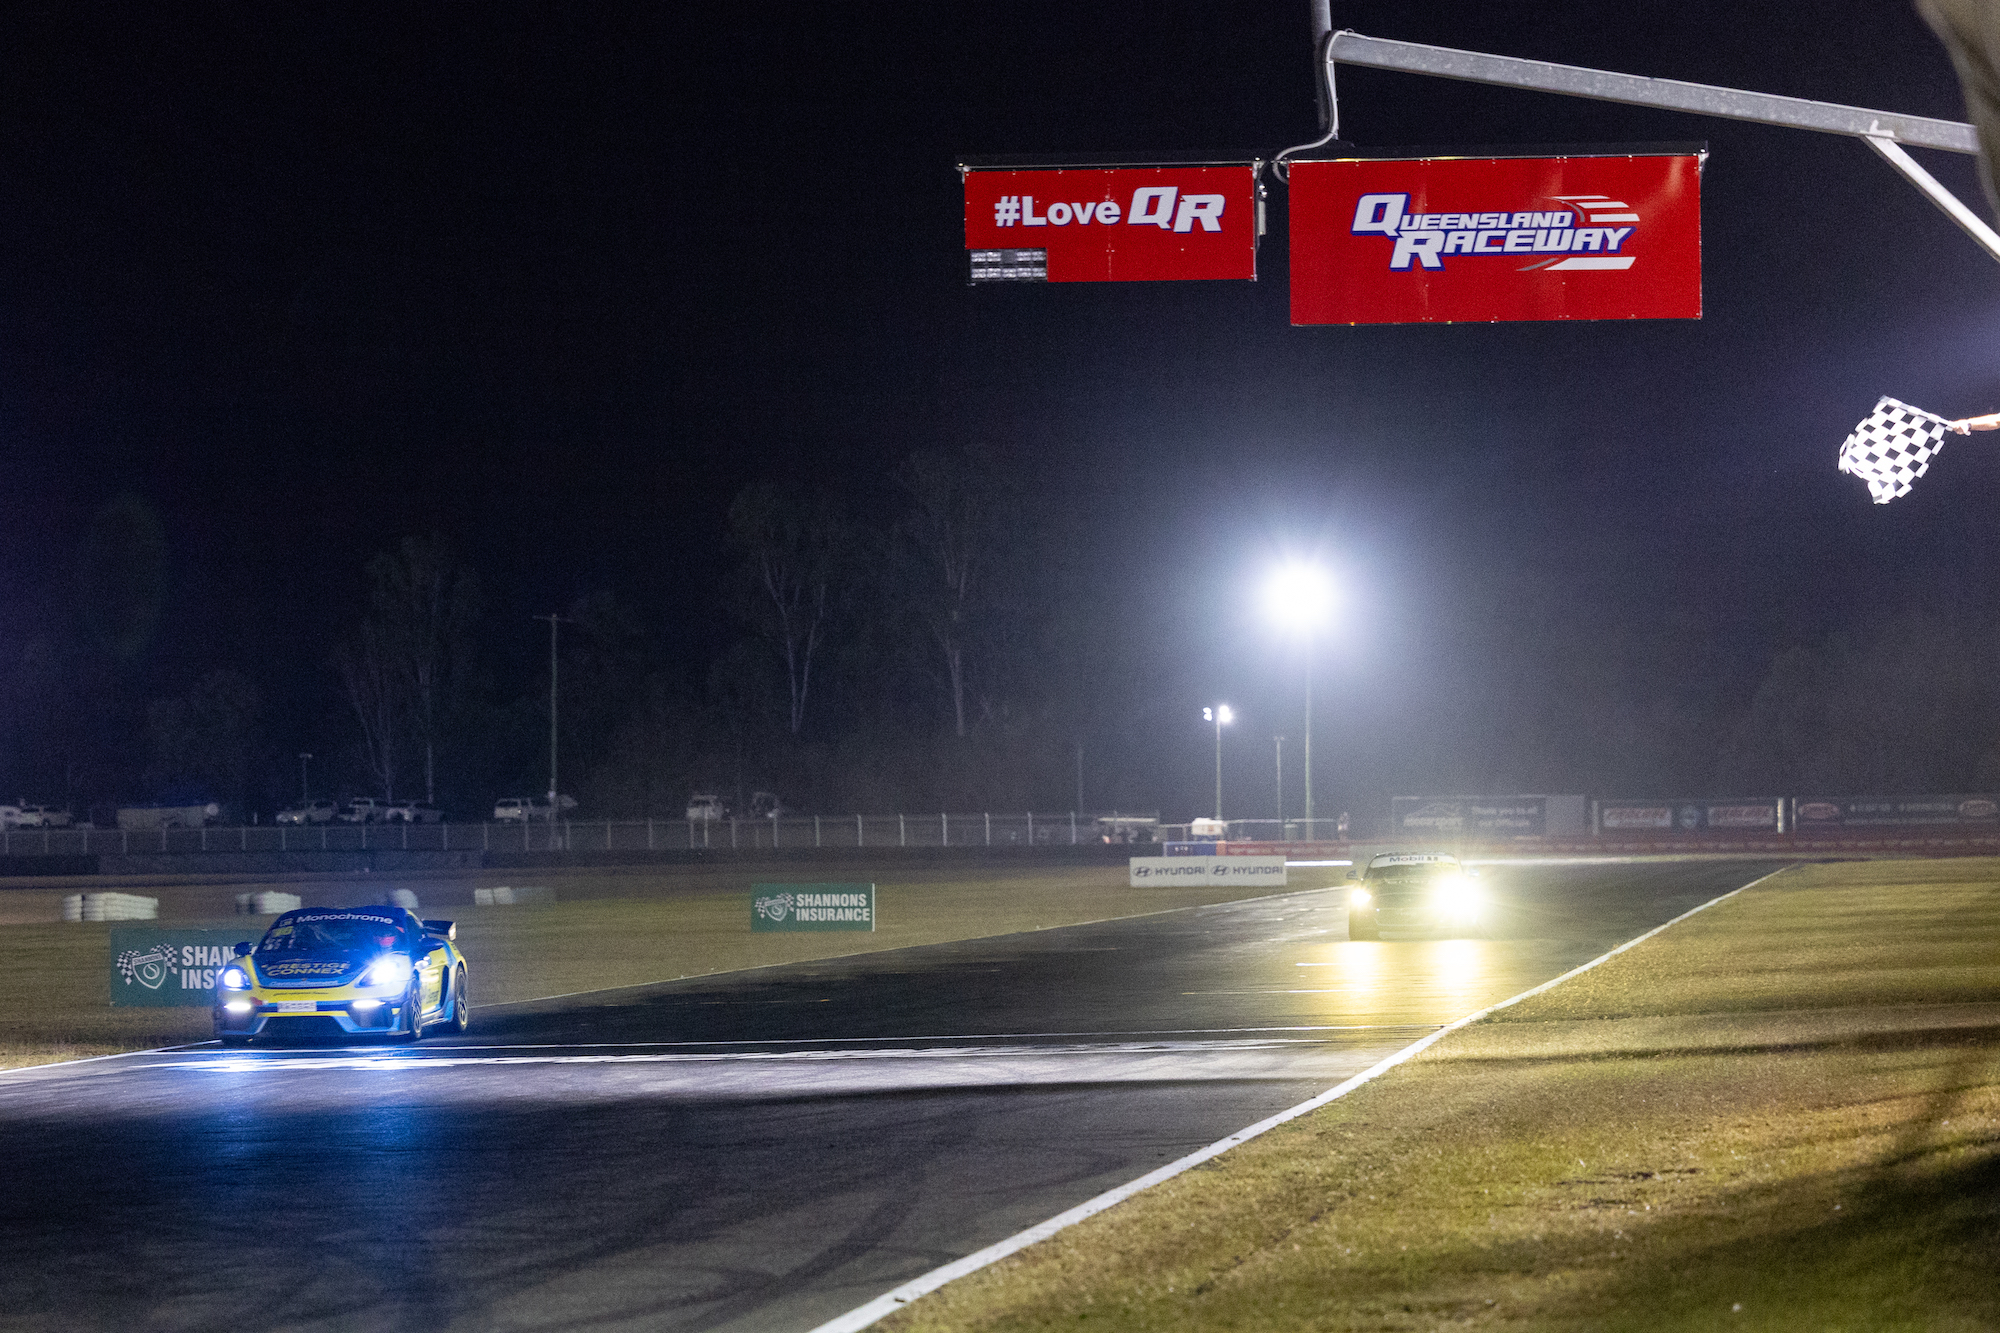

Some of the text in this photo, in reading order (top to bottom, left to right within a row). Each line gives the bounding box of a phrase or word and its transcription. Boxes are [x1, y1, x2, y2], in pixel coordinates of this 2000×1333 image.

[995, 186, 1226, 233] #Love QR
[1353, 193, 1573, 236] QUEENSLAND
[1390, 226, 1633, 270] RACEWAY
[1389, 854, 1425, 862] Mobil
[1155, 866, 1206, 876] HYUNDAI
[1233, 866, 1284, 875] HYUNDAI
[796, 893, 867, 907] SHANNONS
[296, 913, 394, 925] Monochrome
[796, 908, 870, 921] INSURANCE
[181, 945, 241, 966] SHAN
[266, 962, 351, 971] PRESTIGE
[267, 968, 344, 977] CONNEX
[181, 969, 218, 990] INS
